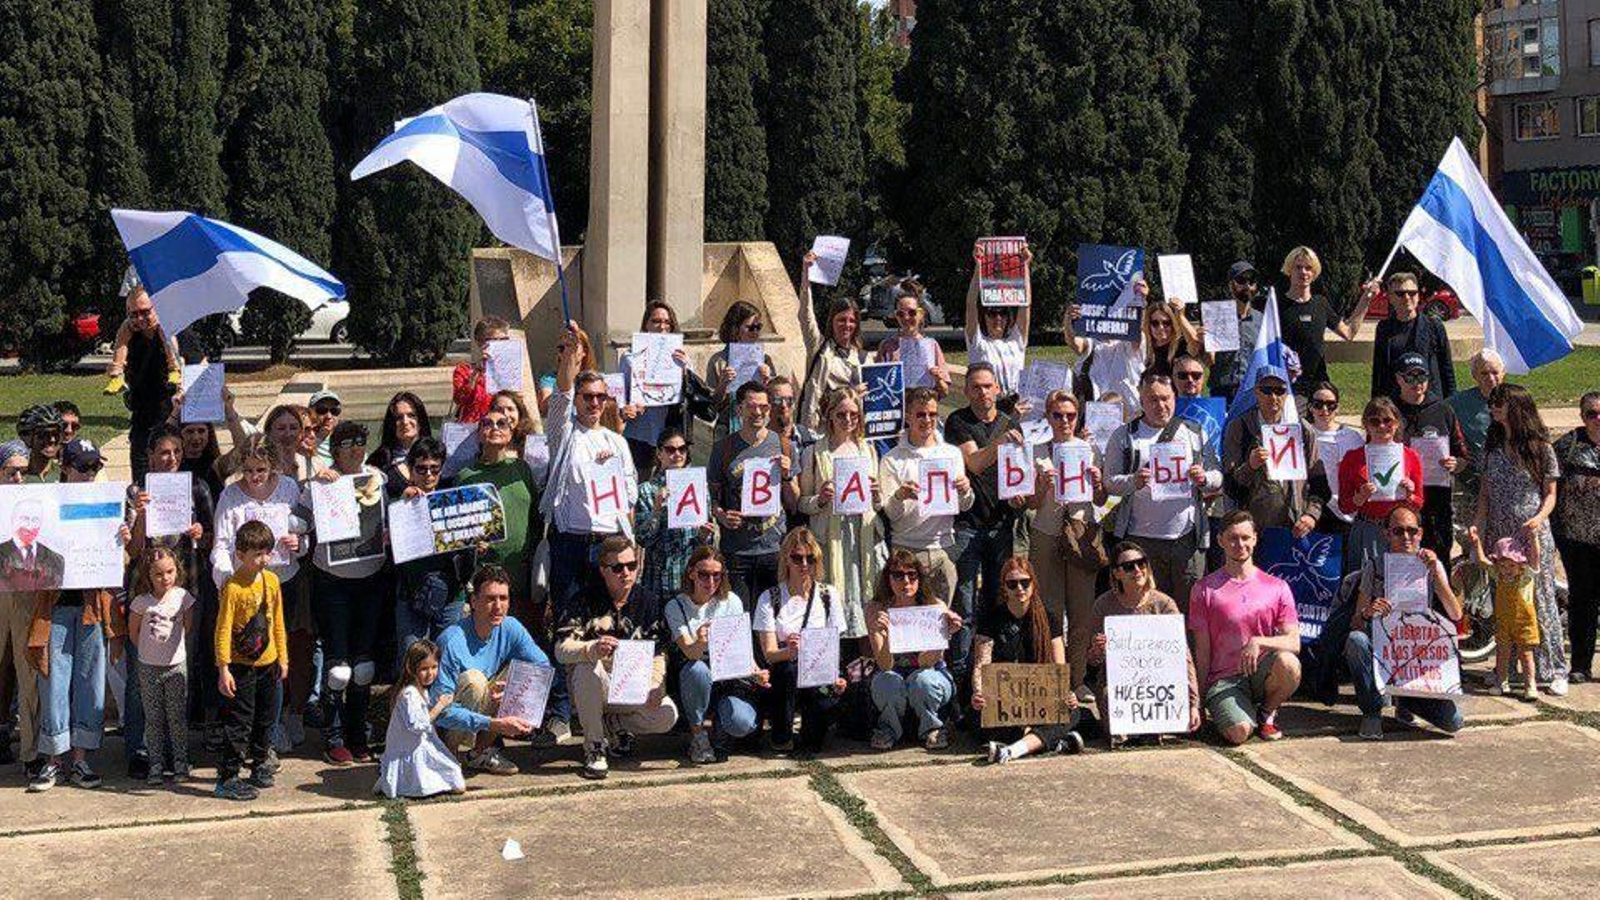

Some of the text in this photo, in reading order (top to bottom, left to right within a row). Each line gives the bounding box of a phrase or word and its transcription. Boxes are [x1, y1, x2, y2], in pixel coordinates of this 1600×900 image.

[1530, 171, 1600, 192] FACTORY
[752, 469, 772, 505] В
[841, 471, 865, 503] А
[923, 471, 950, 504] Л
[1060, 460, 1086, 495] Н
[591, 475, 621, 514] Н
[676, 482, 701, 516] А
[1382, 645, 1389, 660] A
[996, 669, 1047, 699] Putin
[1114, 684, 1175, 702] HUESOS
[997, 699, 1047, 722] huilo
